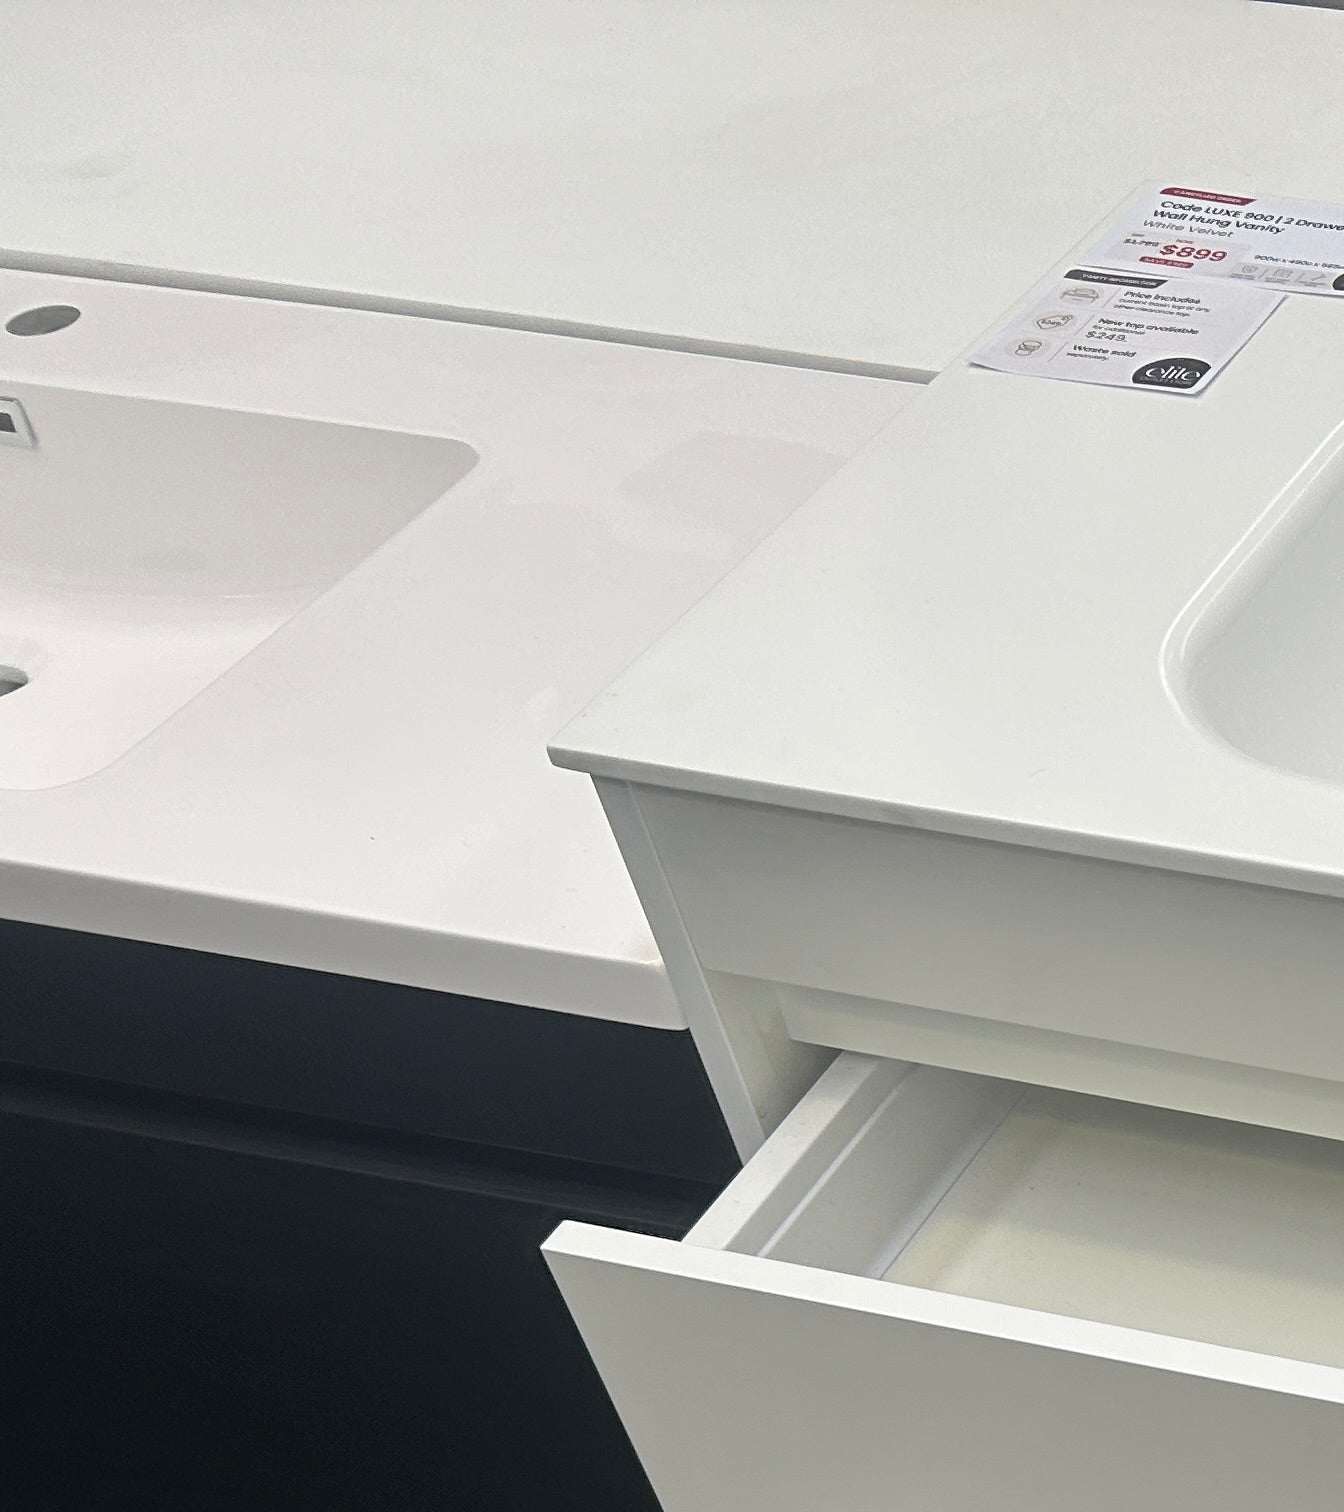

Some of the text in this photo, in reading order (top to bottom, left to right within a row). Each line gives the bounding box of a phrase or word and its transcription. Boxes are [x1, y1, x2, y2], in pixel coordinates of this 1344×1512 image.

[1160, 201, 1203, 212] Code
[1204, 206, 1242, 218] LUXE
[1244, 212, 1275, 222] 900
[1284, 217, 1296, 225] 2
[1143, 220, 1235, 238] White Velvet
[1153, 210, 1285, 234] Wall Hung Vanity
[1159, 244, 1228, 262] $899
[1124, 291, 1201, 305] Price includes
[1146, 324, 1199, 335] available
[1073, 344, 1138, 358] Waste sold
[1145, 365, 1201, 381] elite
